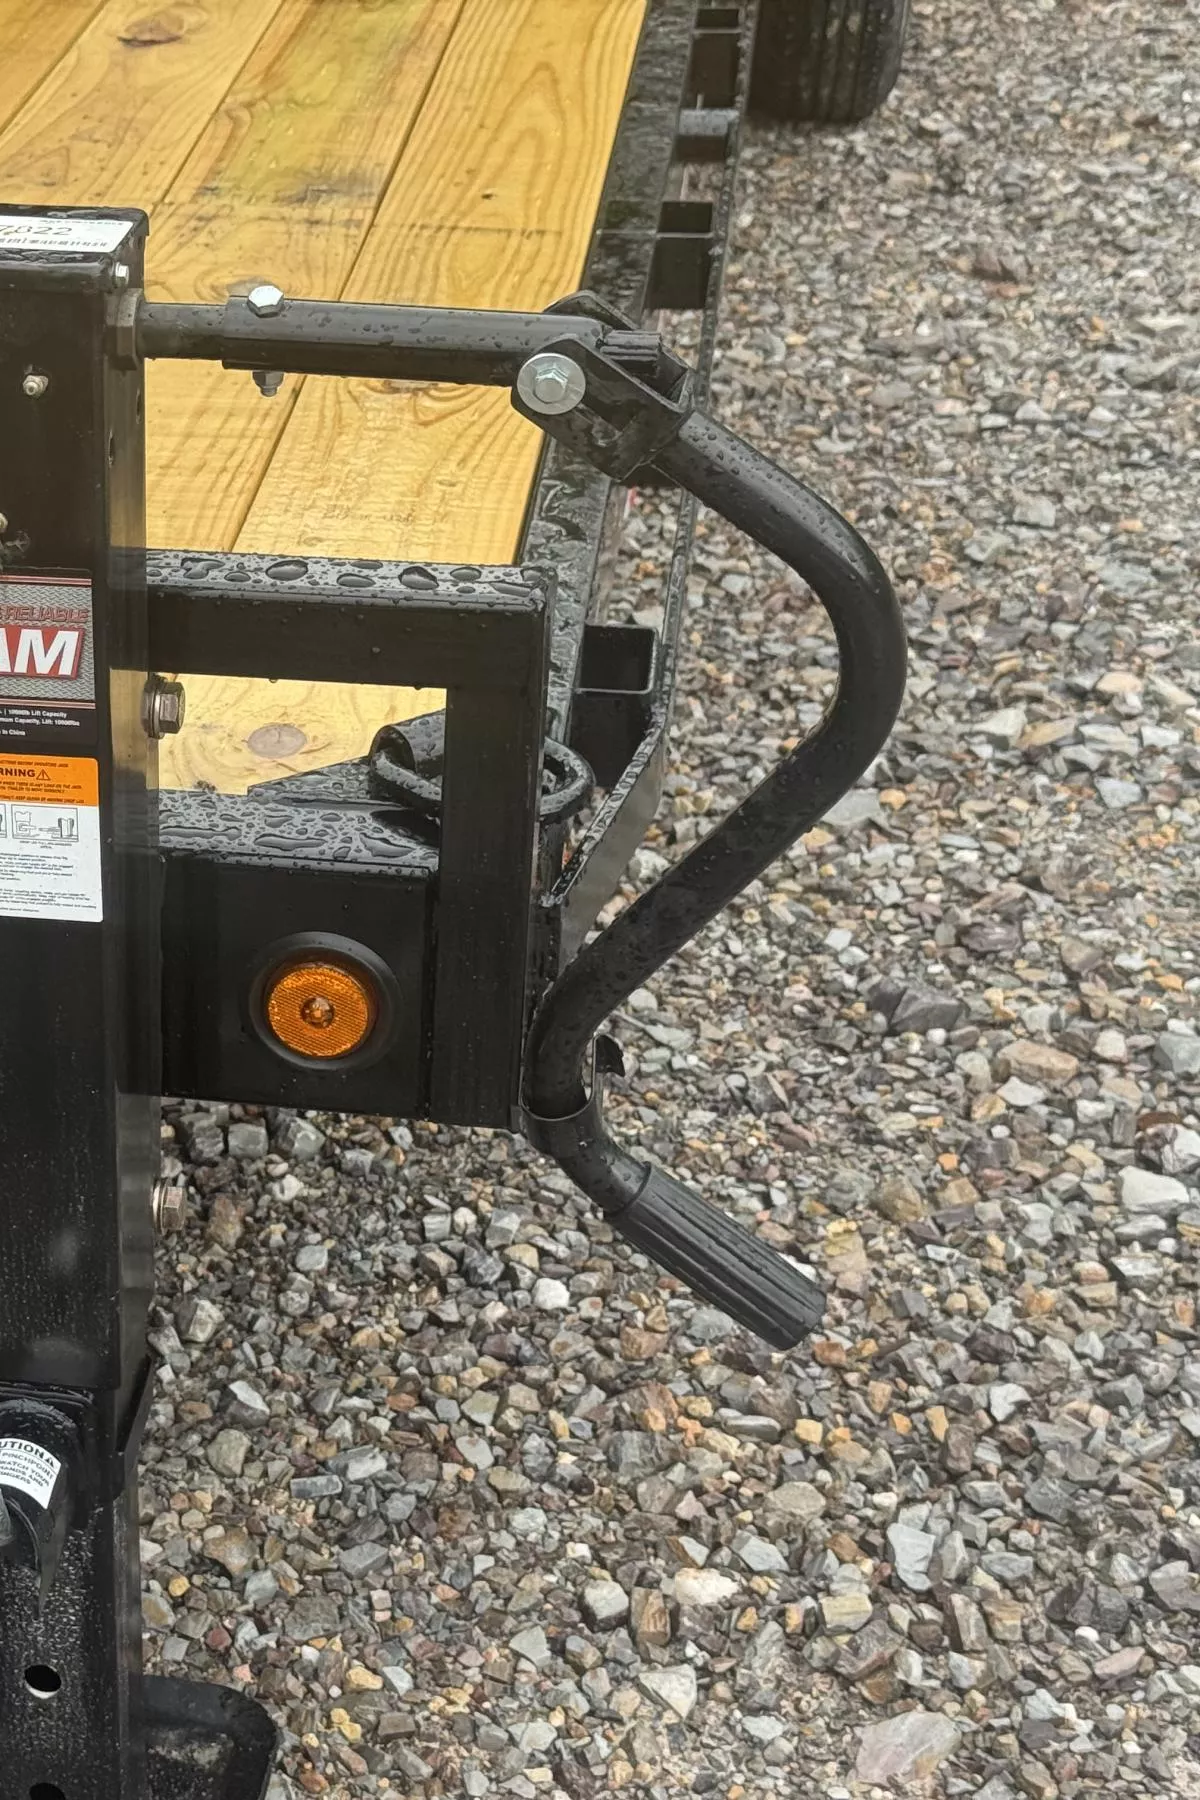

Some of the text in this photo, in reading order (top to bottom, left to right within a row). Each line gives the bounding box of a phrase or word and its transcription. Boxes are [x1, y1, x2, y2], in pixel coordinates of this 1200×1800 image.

[0, 1460, 50, 1486] WATCH YOUR
[28, 1474, 43, 1487] AND
